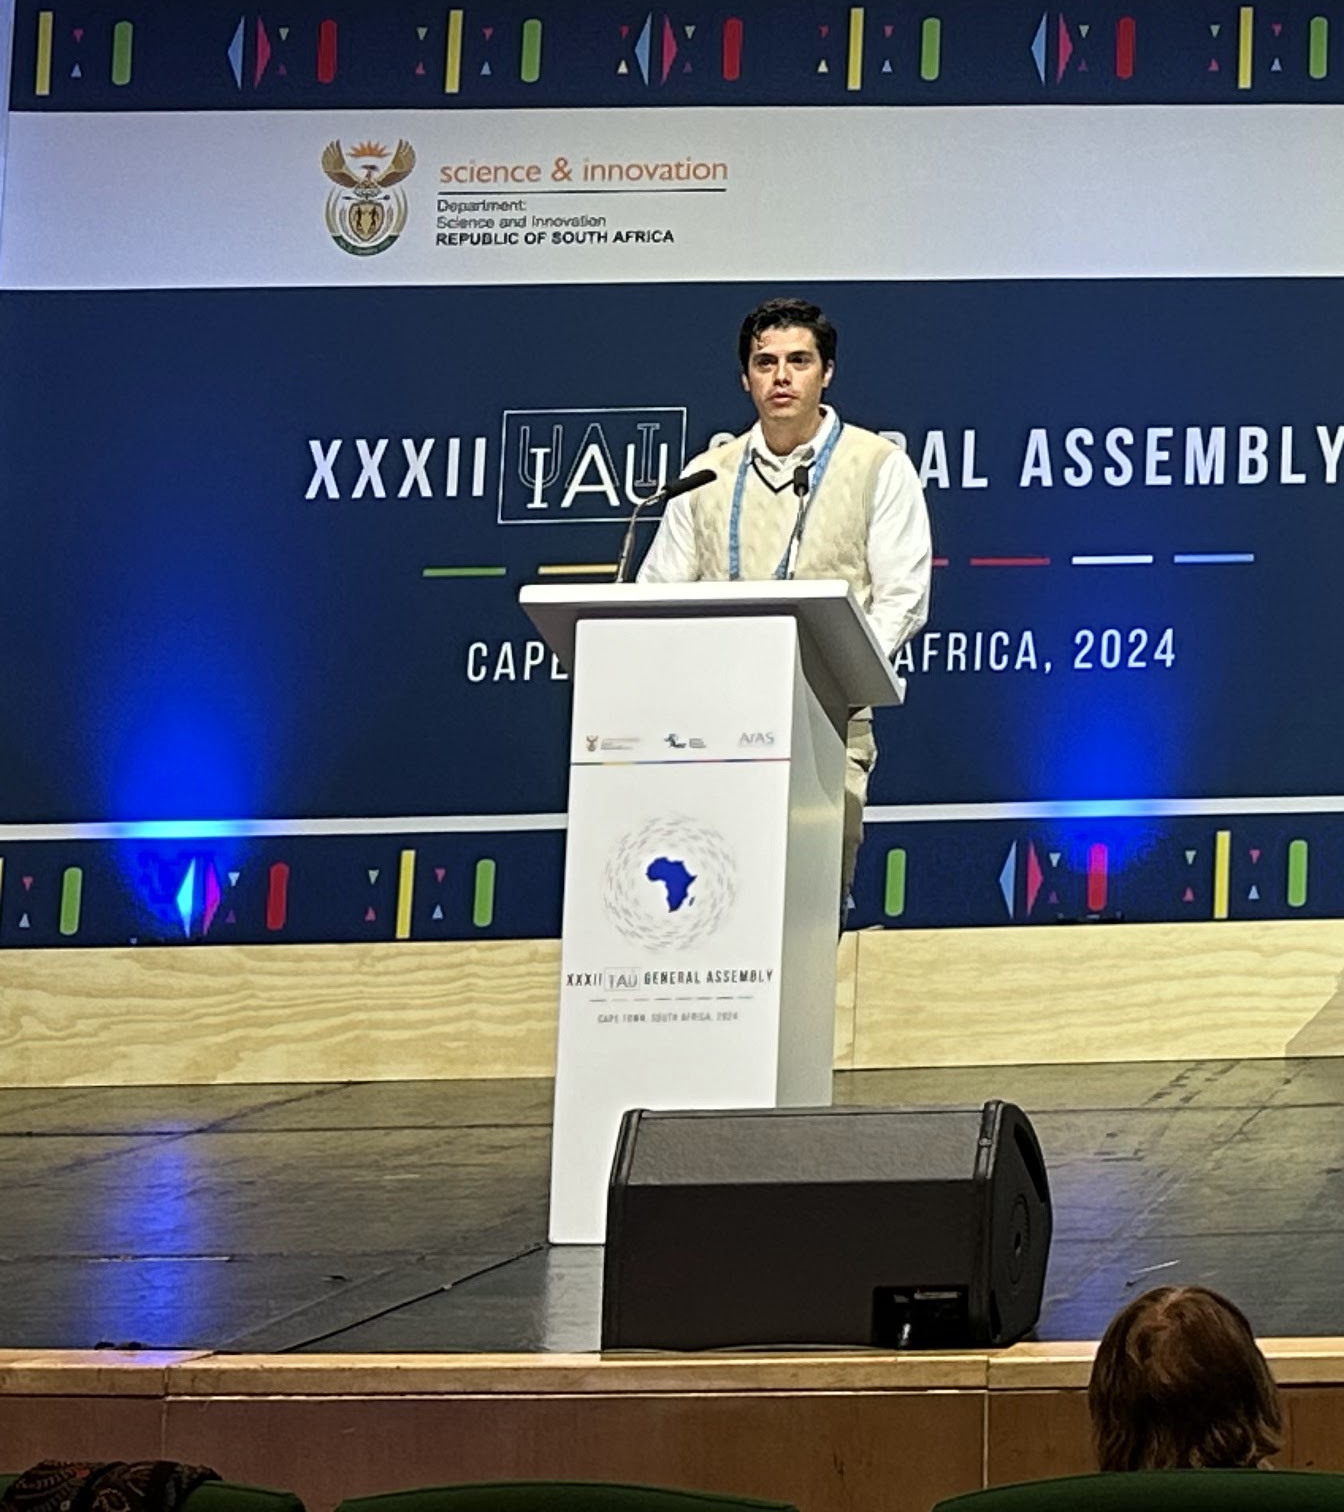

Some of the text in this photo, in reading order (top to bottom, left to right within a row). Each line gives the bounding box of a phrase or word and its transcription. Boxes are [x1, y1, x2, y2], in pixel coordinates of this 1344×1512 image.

[439, 156, 728, 183] science & innovation
[436, 214, 607, 229] Science and Innovation
[435, 228, 675, 247] REPUBLIC OF SOUTH AFRICA
[304, 436, 487, 500] XXXII
[526, 442, 669, 509] IAU
[894, 630, 1052, 674] AFRICA,
[1073, 628, 1175, 670] 2024
[644, 971, 701, 986] GENERAL
[706, 969, 774, 985] ASSEMBLY
